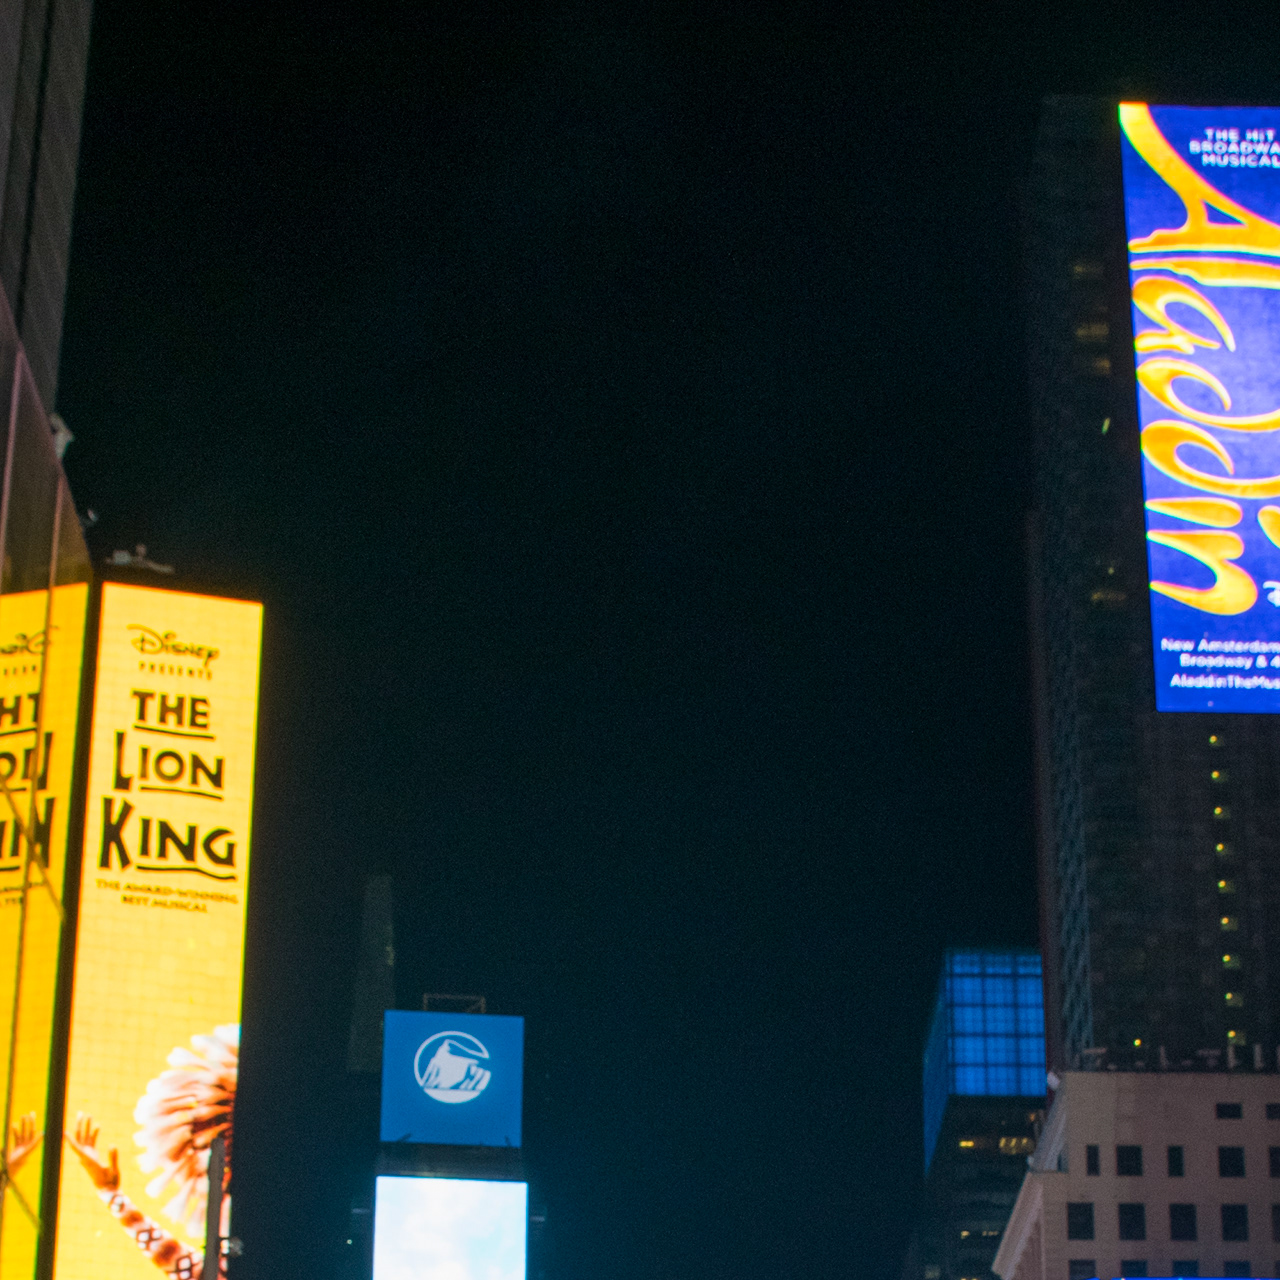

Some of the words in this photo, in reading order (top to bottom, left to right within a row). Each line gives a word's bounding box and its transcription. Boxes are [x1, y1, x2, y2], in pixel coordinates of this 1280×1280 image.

[1204, 127, 1239, 142] THE
[1245, 128, 1276, 142] HIT
[127, 623, 219, 668] Disney
[1161, 637, 1195, 651] New
[139, 660, 212, 680] PRESENTS
[1180, 652, 1253, 669] Broadway
[1255, 655, 1268, 668] &
[131, 690, 210, 730] THE
[114, 731, 224, 790] LION
[99, 796, 237, 870] KING
